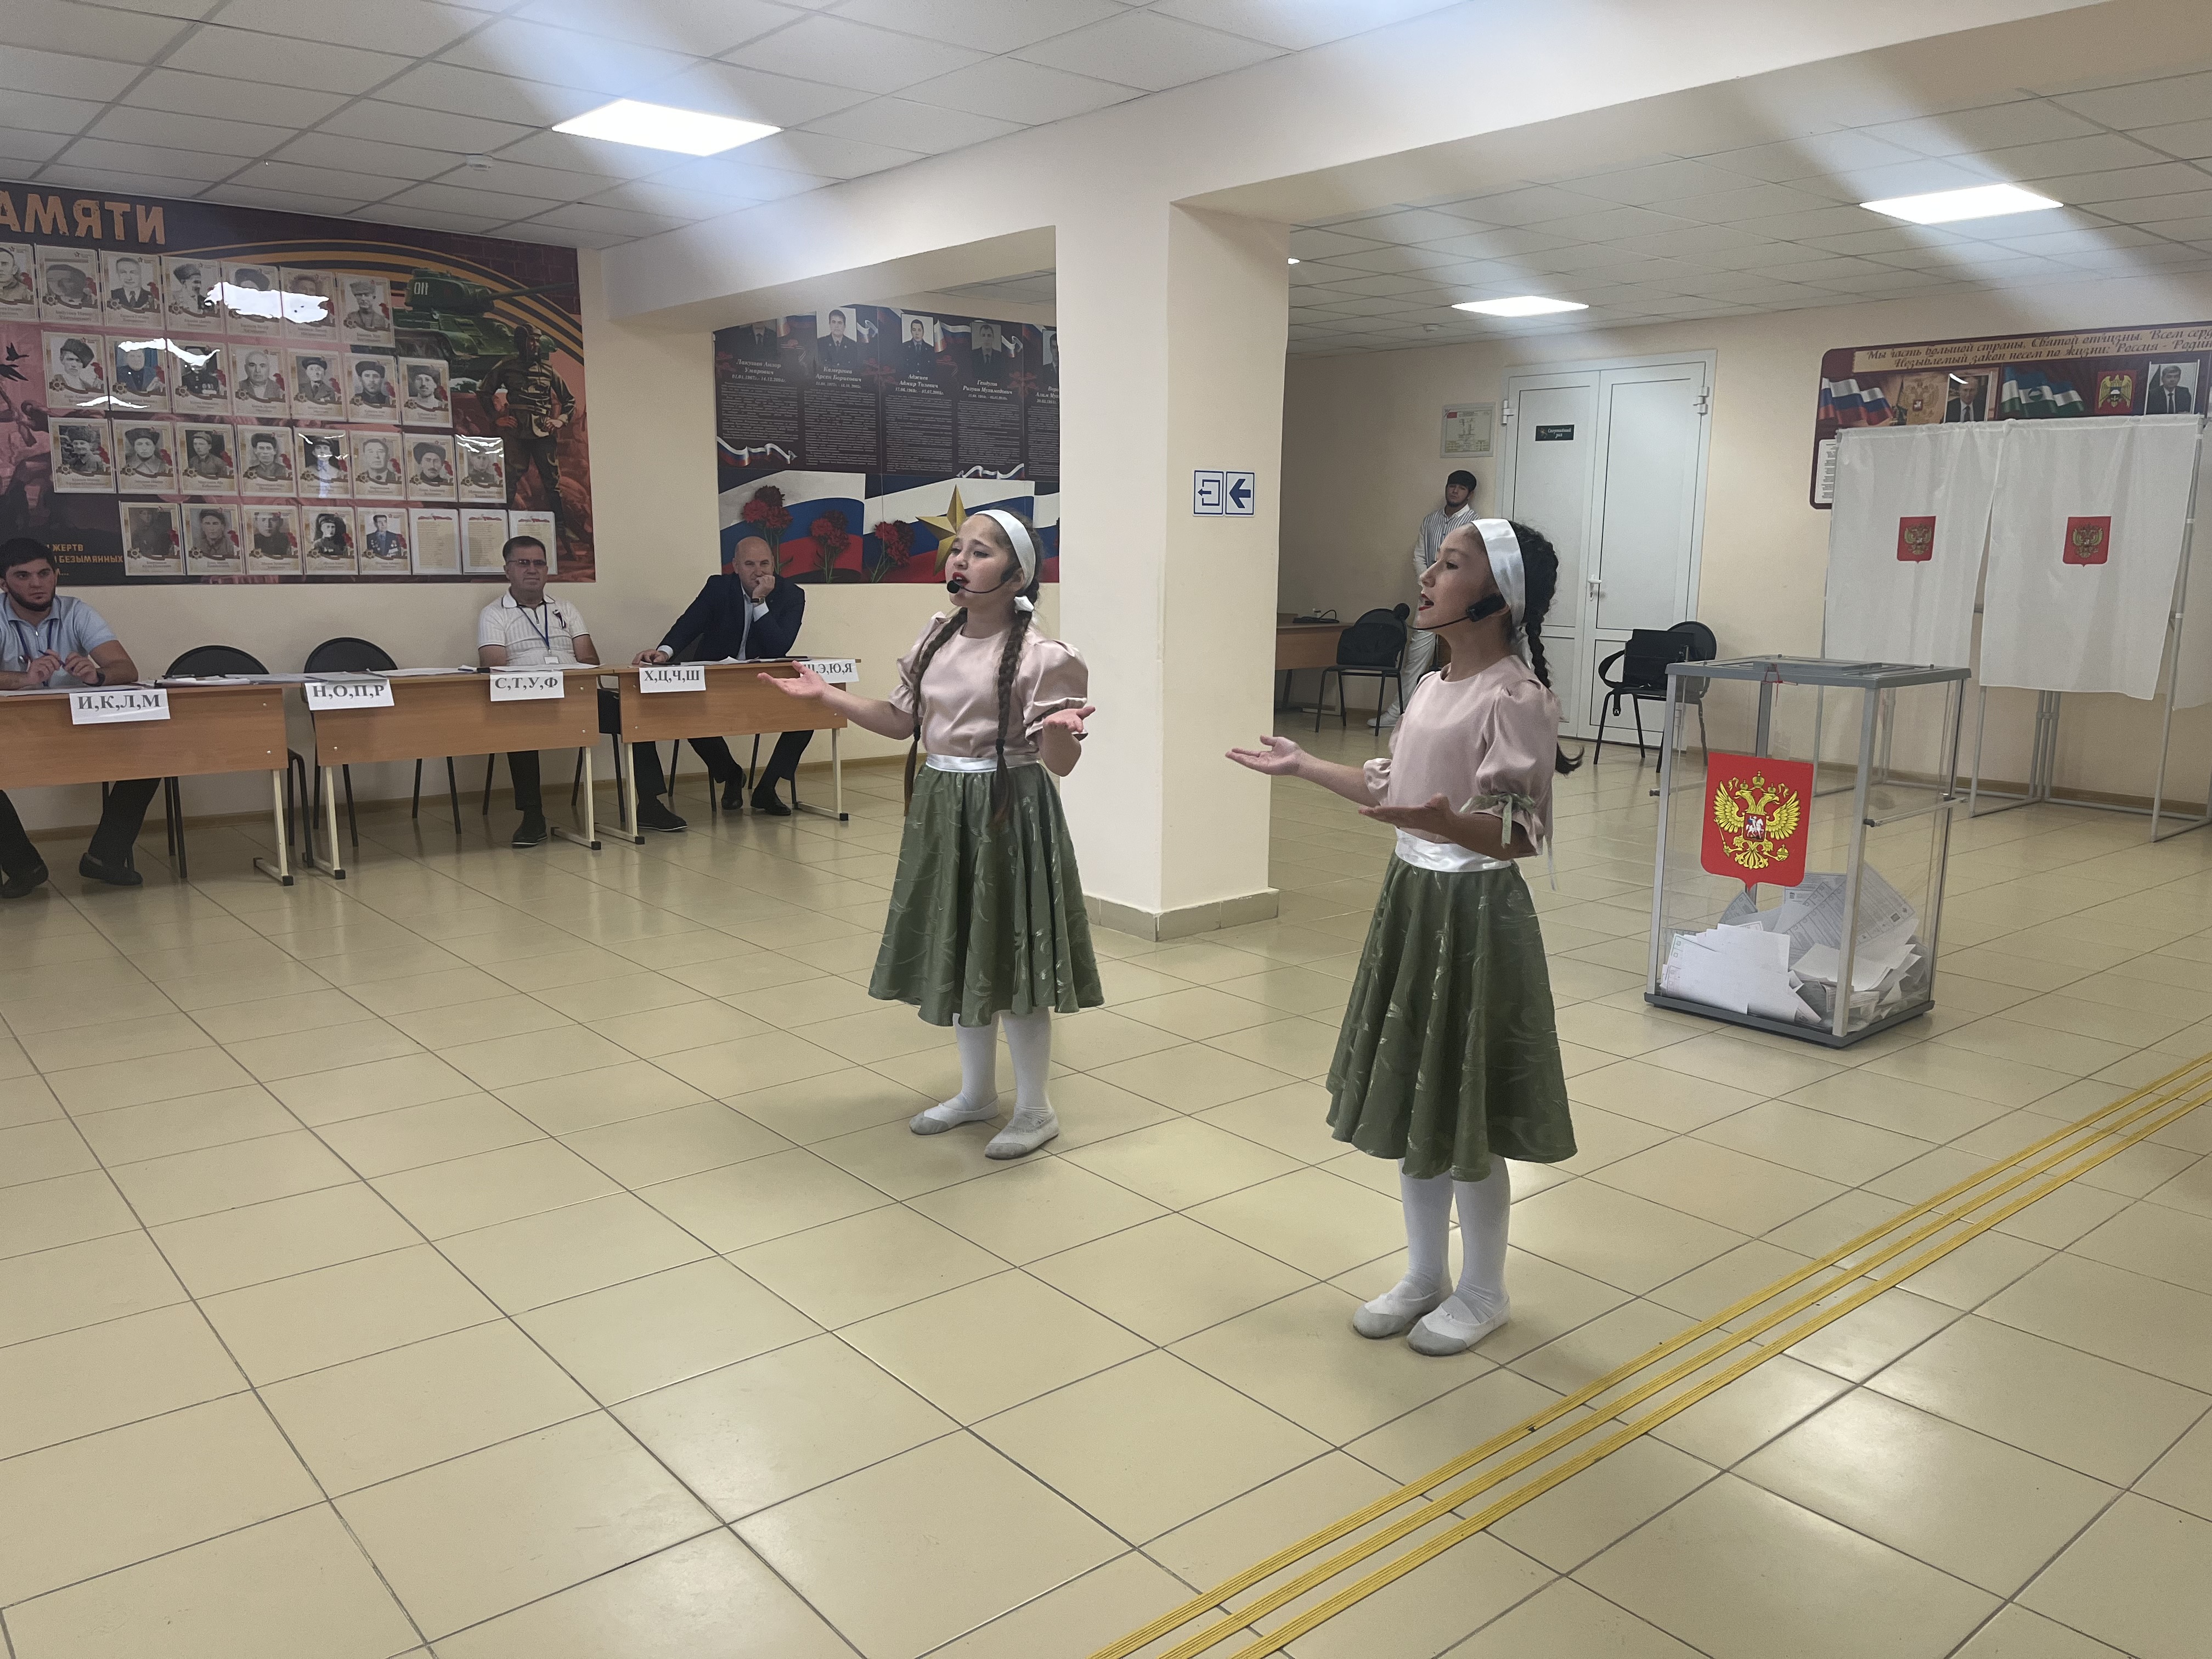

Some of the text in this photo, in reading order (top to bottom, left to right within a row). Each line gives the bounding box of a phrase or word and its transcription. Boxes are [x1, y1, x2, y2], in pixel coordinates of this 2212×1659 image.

[414, 282, 428, 295] 011
[1867, 350, 1887, 360] Мы
[1892, 348, 1922, 358] часть
[1926, 343, 1974, 357] большой
[2149, 329, 2183, 340] Всем
[1894, 356, 1968, 369] Незыблемый
[1969, 351, 2005, 365] закон
[2116, 342, 2158, 353] Россия
[495, 676, 558, 691] С,Т,У,Ф
[644, 670, 700, 683] Х,Ц,Ч,Ш
[77, 694, 161, 711] И,К,Л,М
